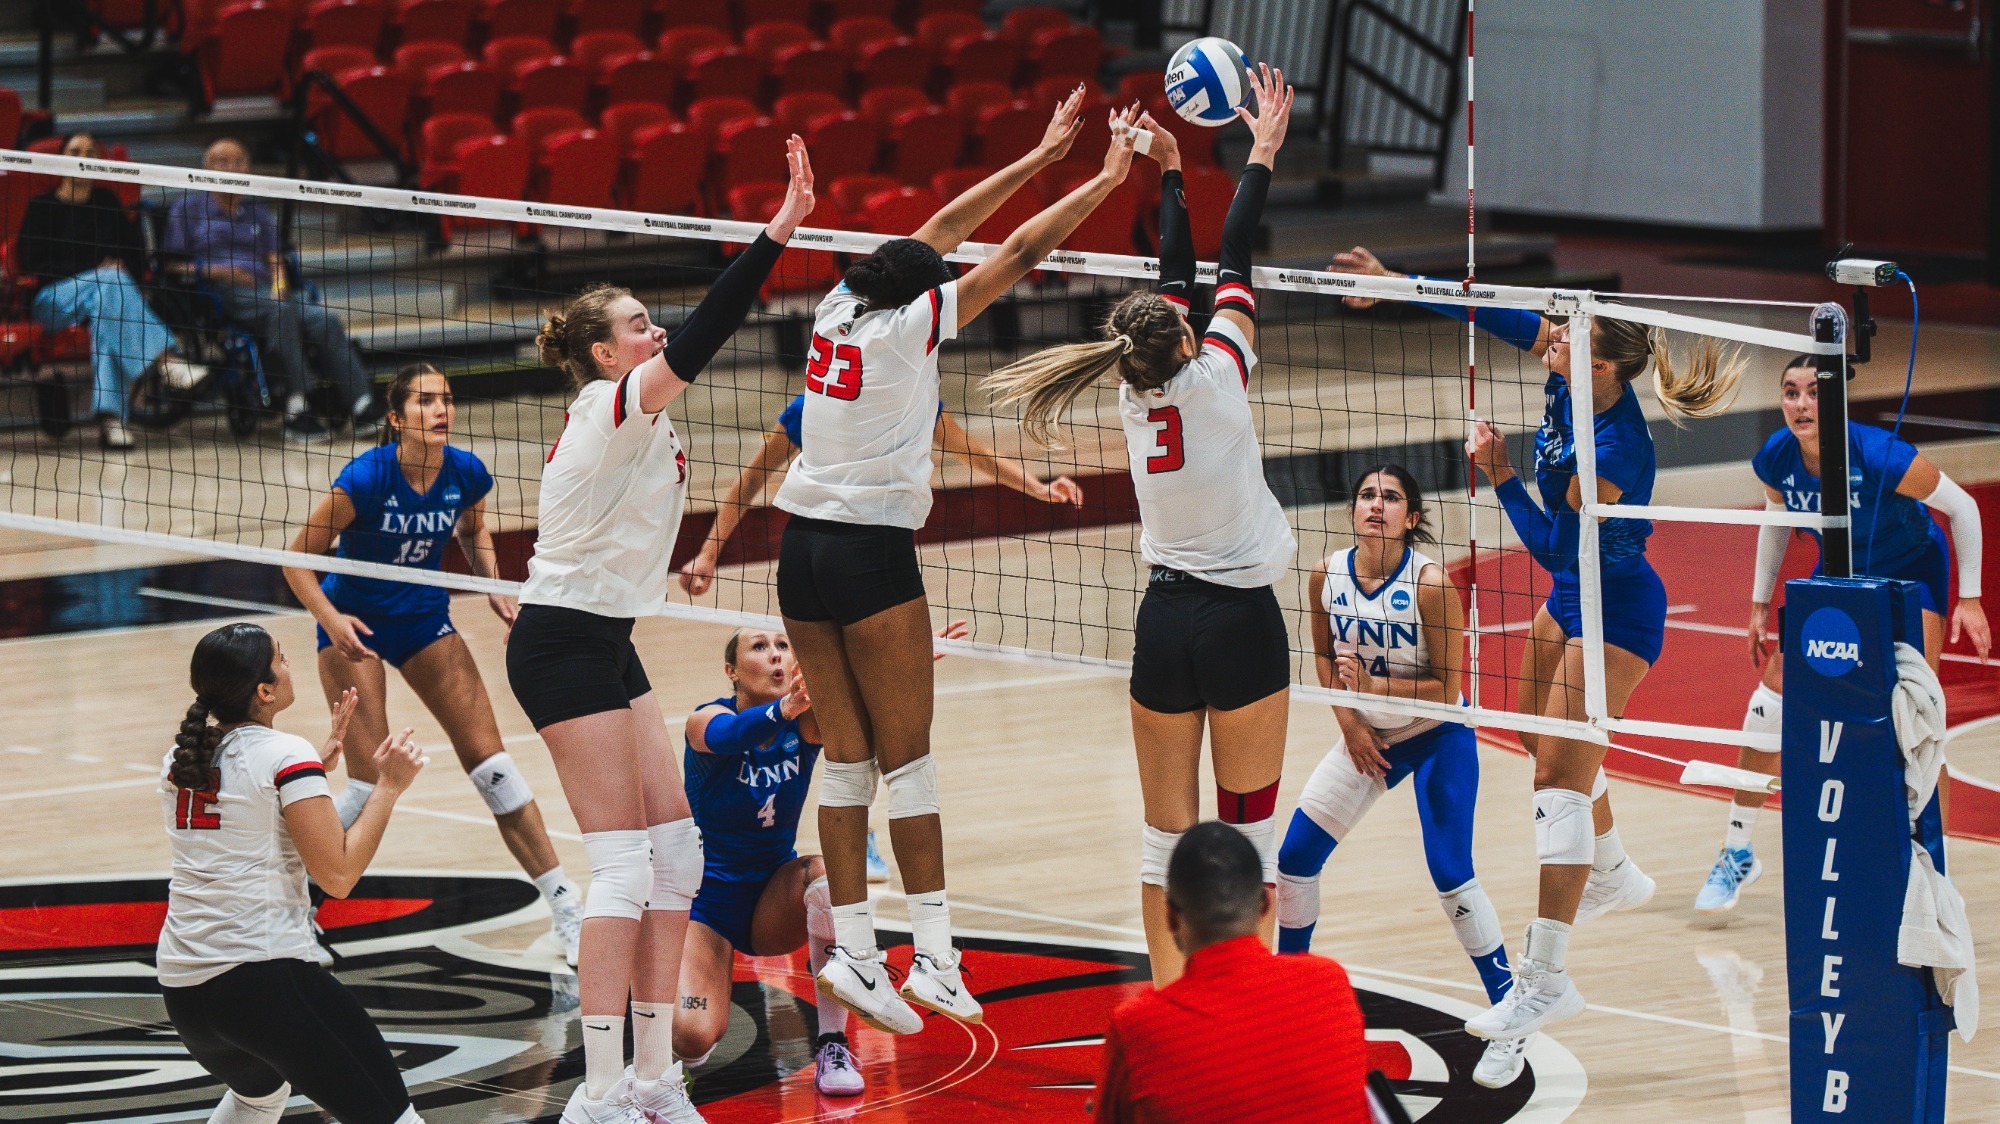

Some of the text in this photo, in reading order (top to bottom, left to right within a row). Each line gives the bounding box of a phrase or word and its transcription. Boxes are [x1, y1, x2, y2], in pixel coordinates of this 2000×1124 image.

[305, 186, 362, 198] VOLLEYBALL CHAMPIONSHIP
[418, 197, 476, 209] VOLLEYBALL CHAMPIONSHIP
[533, 208, 592, 220] VOLLEYBALL CHAMPIONSHIP
[651, 219, 712, 232] VOLLEYBALL CHAMPIONSHIP
[798, 233, 834, 243] CHAMPIONSHIP
[1049, 255, 1087, 265] CHAMPIONSHIP
[1287, 274, 1356, 288] VOLLEYBALL CHAMPIONSHIP
[1423, 286, 1454, 296] VOLLEYBALL
[806, 331, 863, 401] 23
[1147, 405, 1185, 474] 3
[380, 509, 456, 534] LYNN
[393, 539, 433, 564] 15
[1332, 613, 1418, 649] YNN
[1806, 639, 1859, 662] NCAA
[736, 755, 800, 788] LYNN
[757, 793, 776, 828] 4
[681, 996, 708, 1010] 1954
